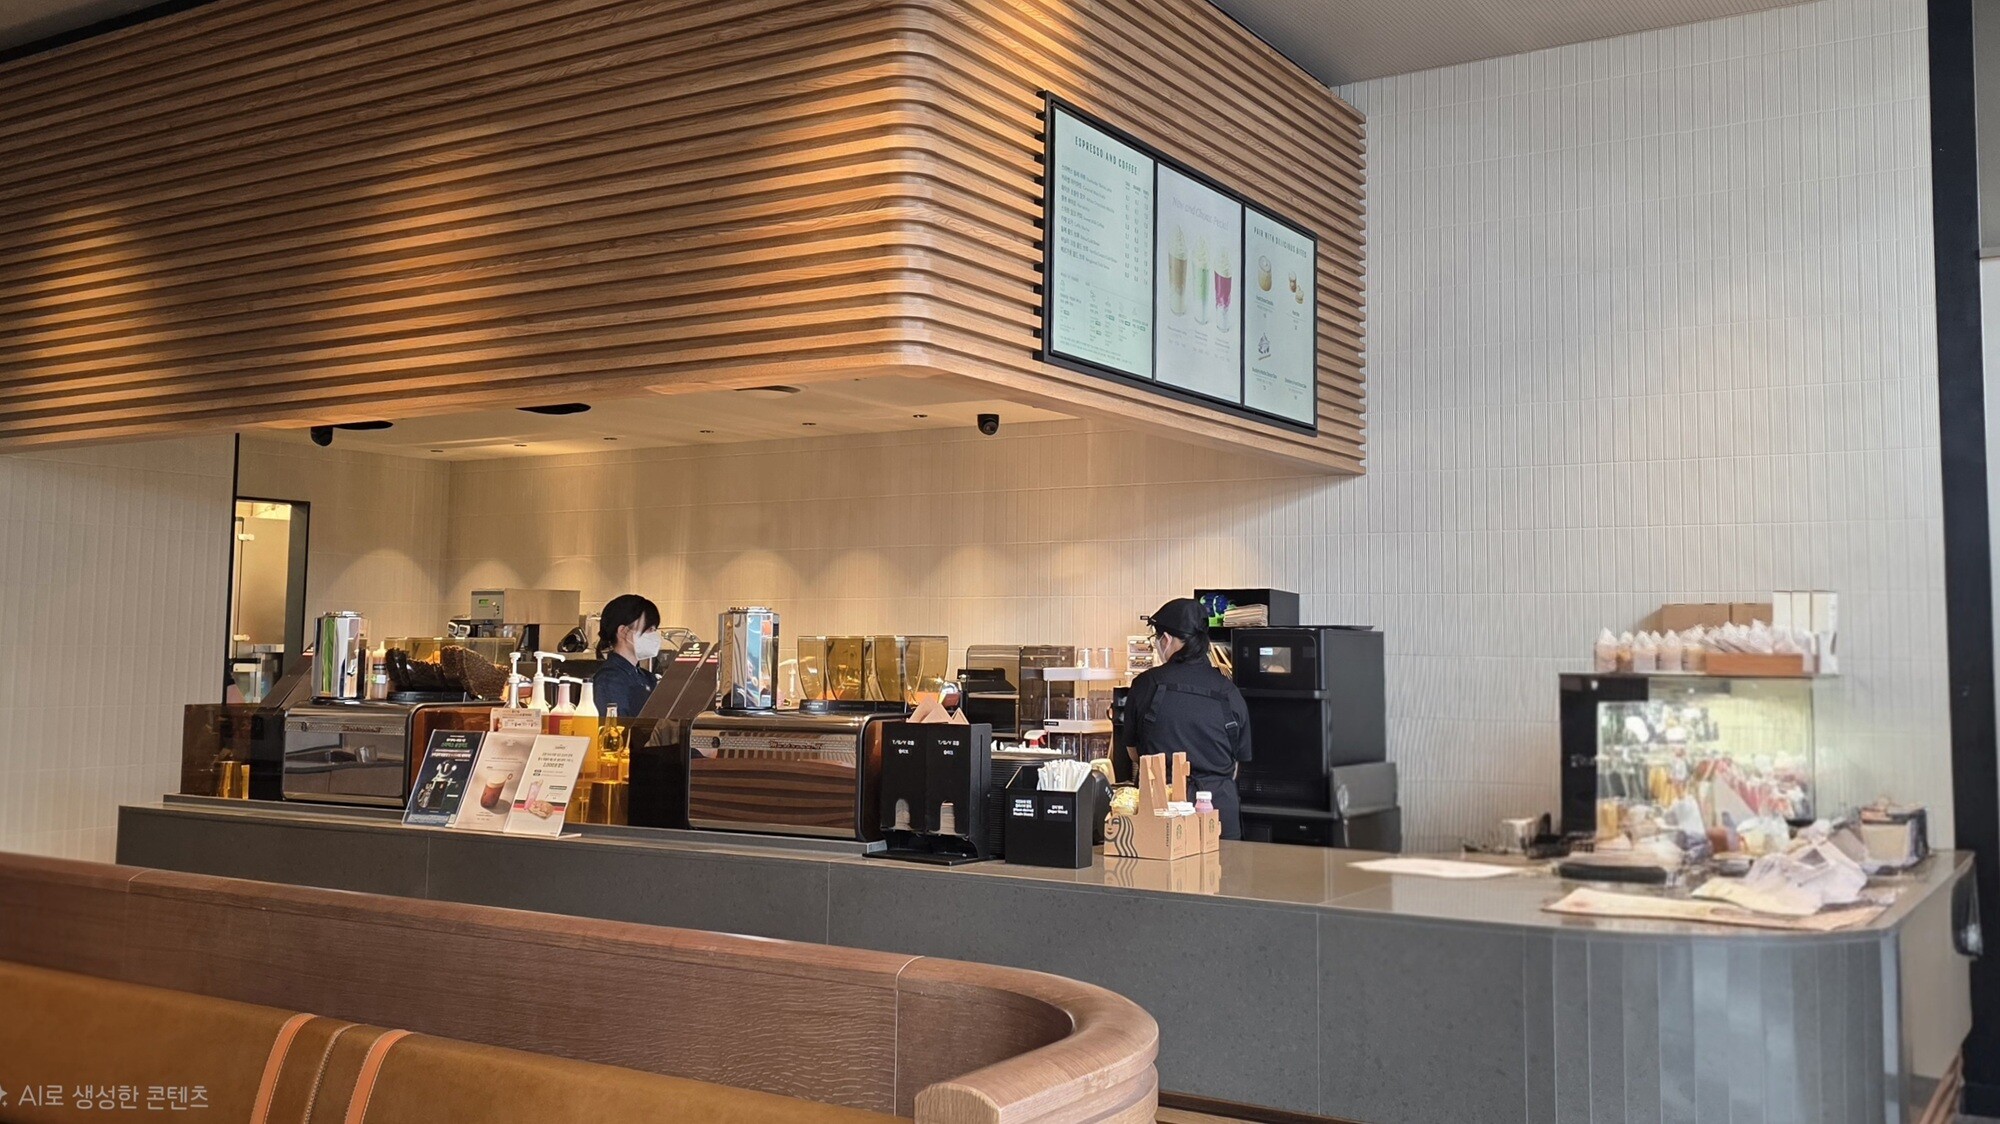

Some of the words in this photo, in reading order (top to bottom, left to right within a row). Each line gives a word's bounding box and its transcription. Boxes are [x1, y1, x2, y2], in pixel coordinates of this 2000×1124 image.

[1075, 136, 1104, 158] ESPRESSO
[1105, 152, 1117, 165] AND
[1118, 159, 1138, 175] COFFEE
